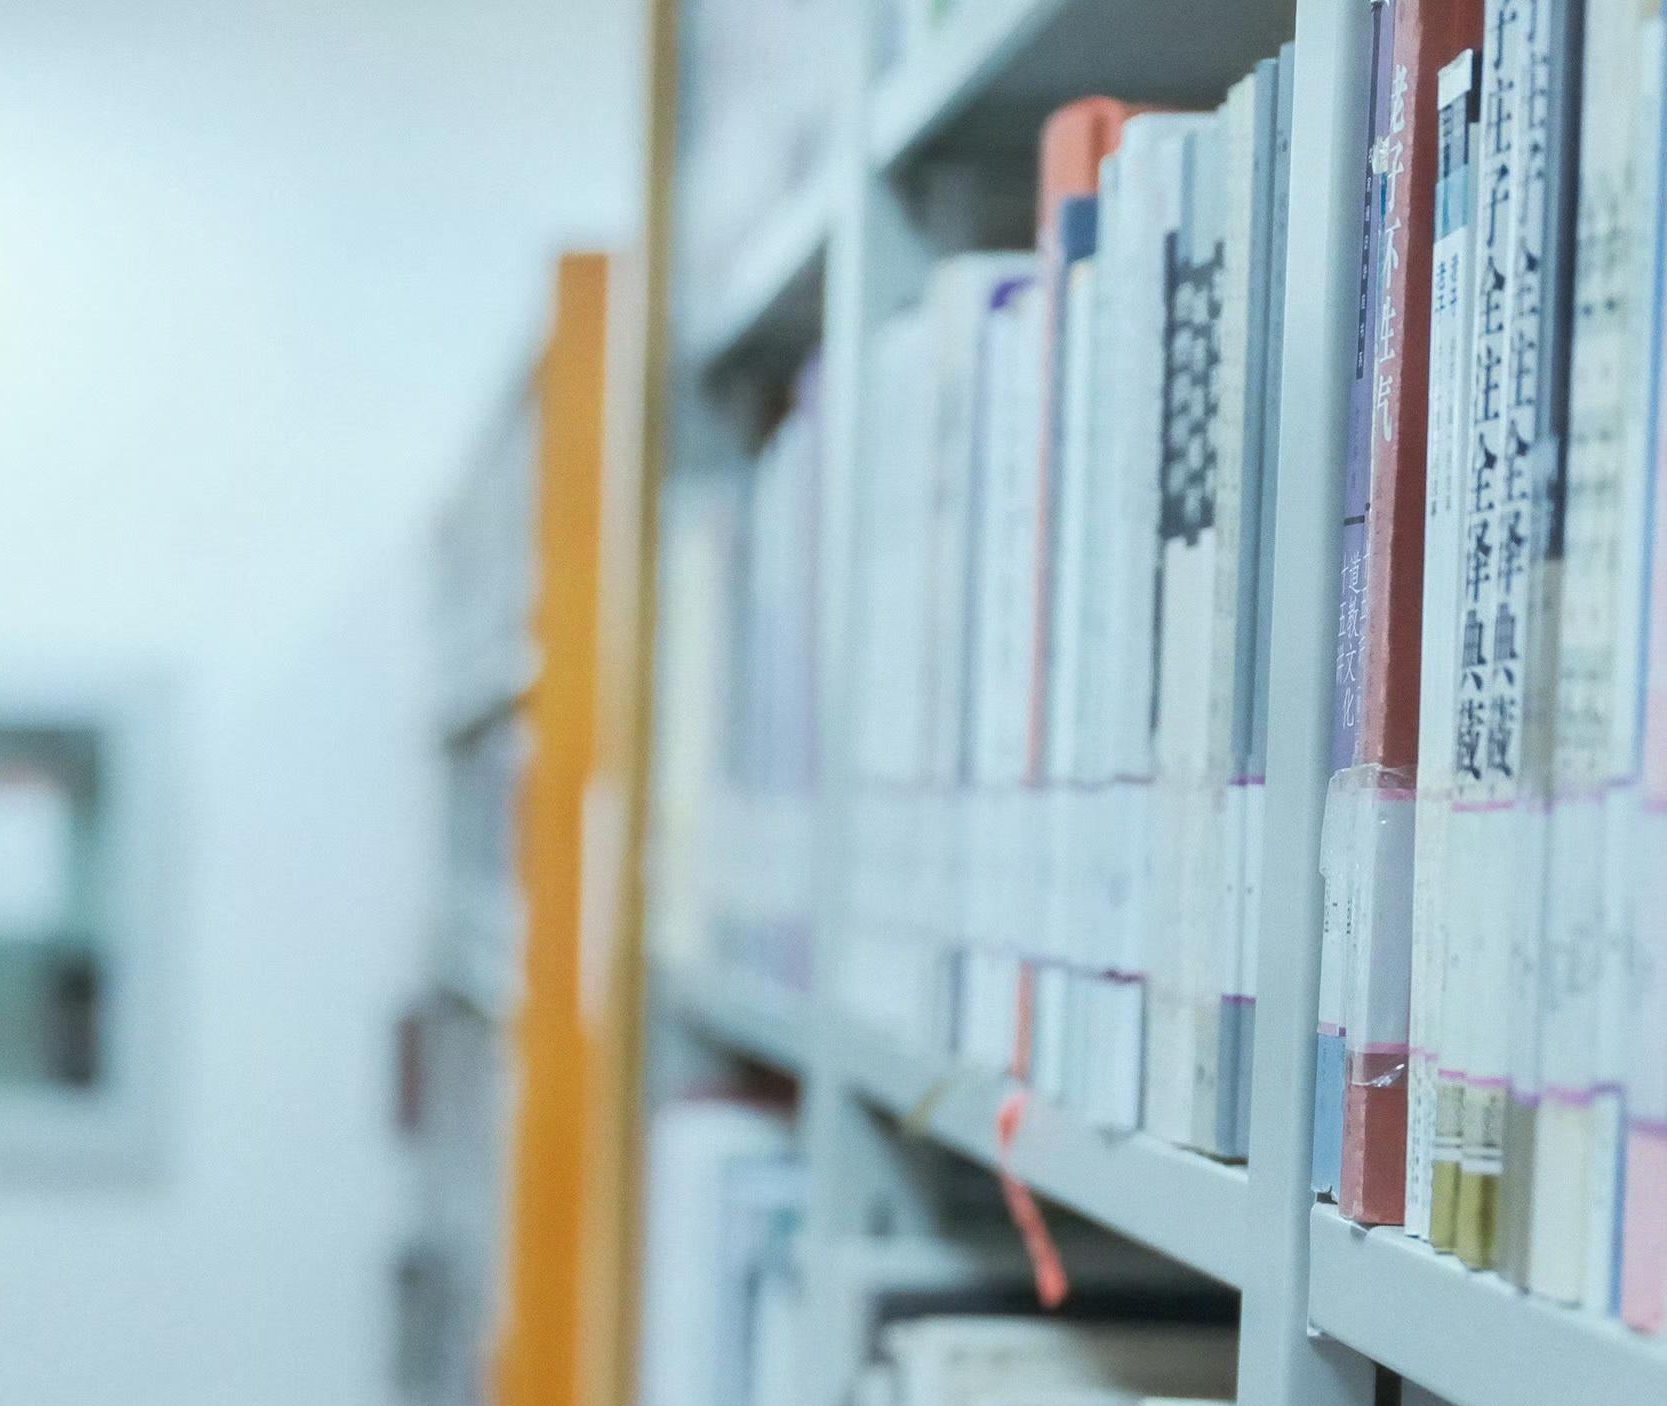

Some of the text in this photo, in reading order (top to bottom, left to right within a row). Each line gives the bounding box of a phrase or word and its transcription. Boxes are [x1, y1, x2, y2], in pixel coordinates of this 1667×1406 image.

[1371, 64, 1409, 442] 老子不生气
[1343, 552, 1363, 729] 道教文化
